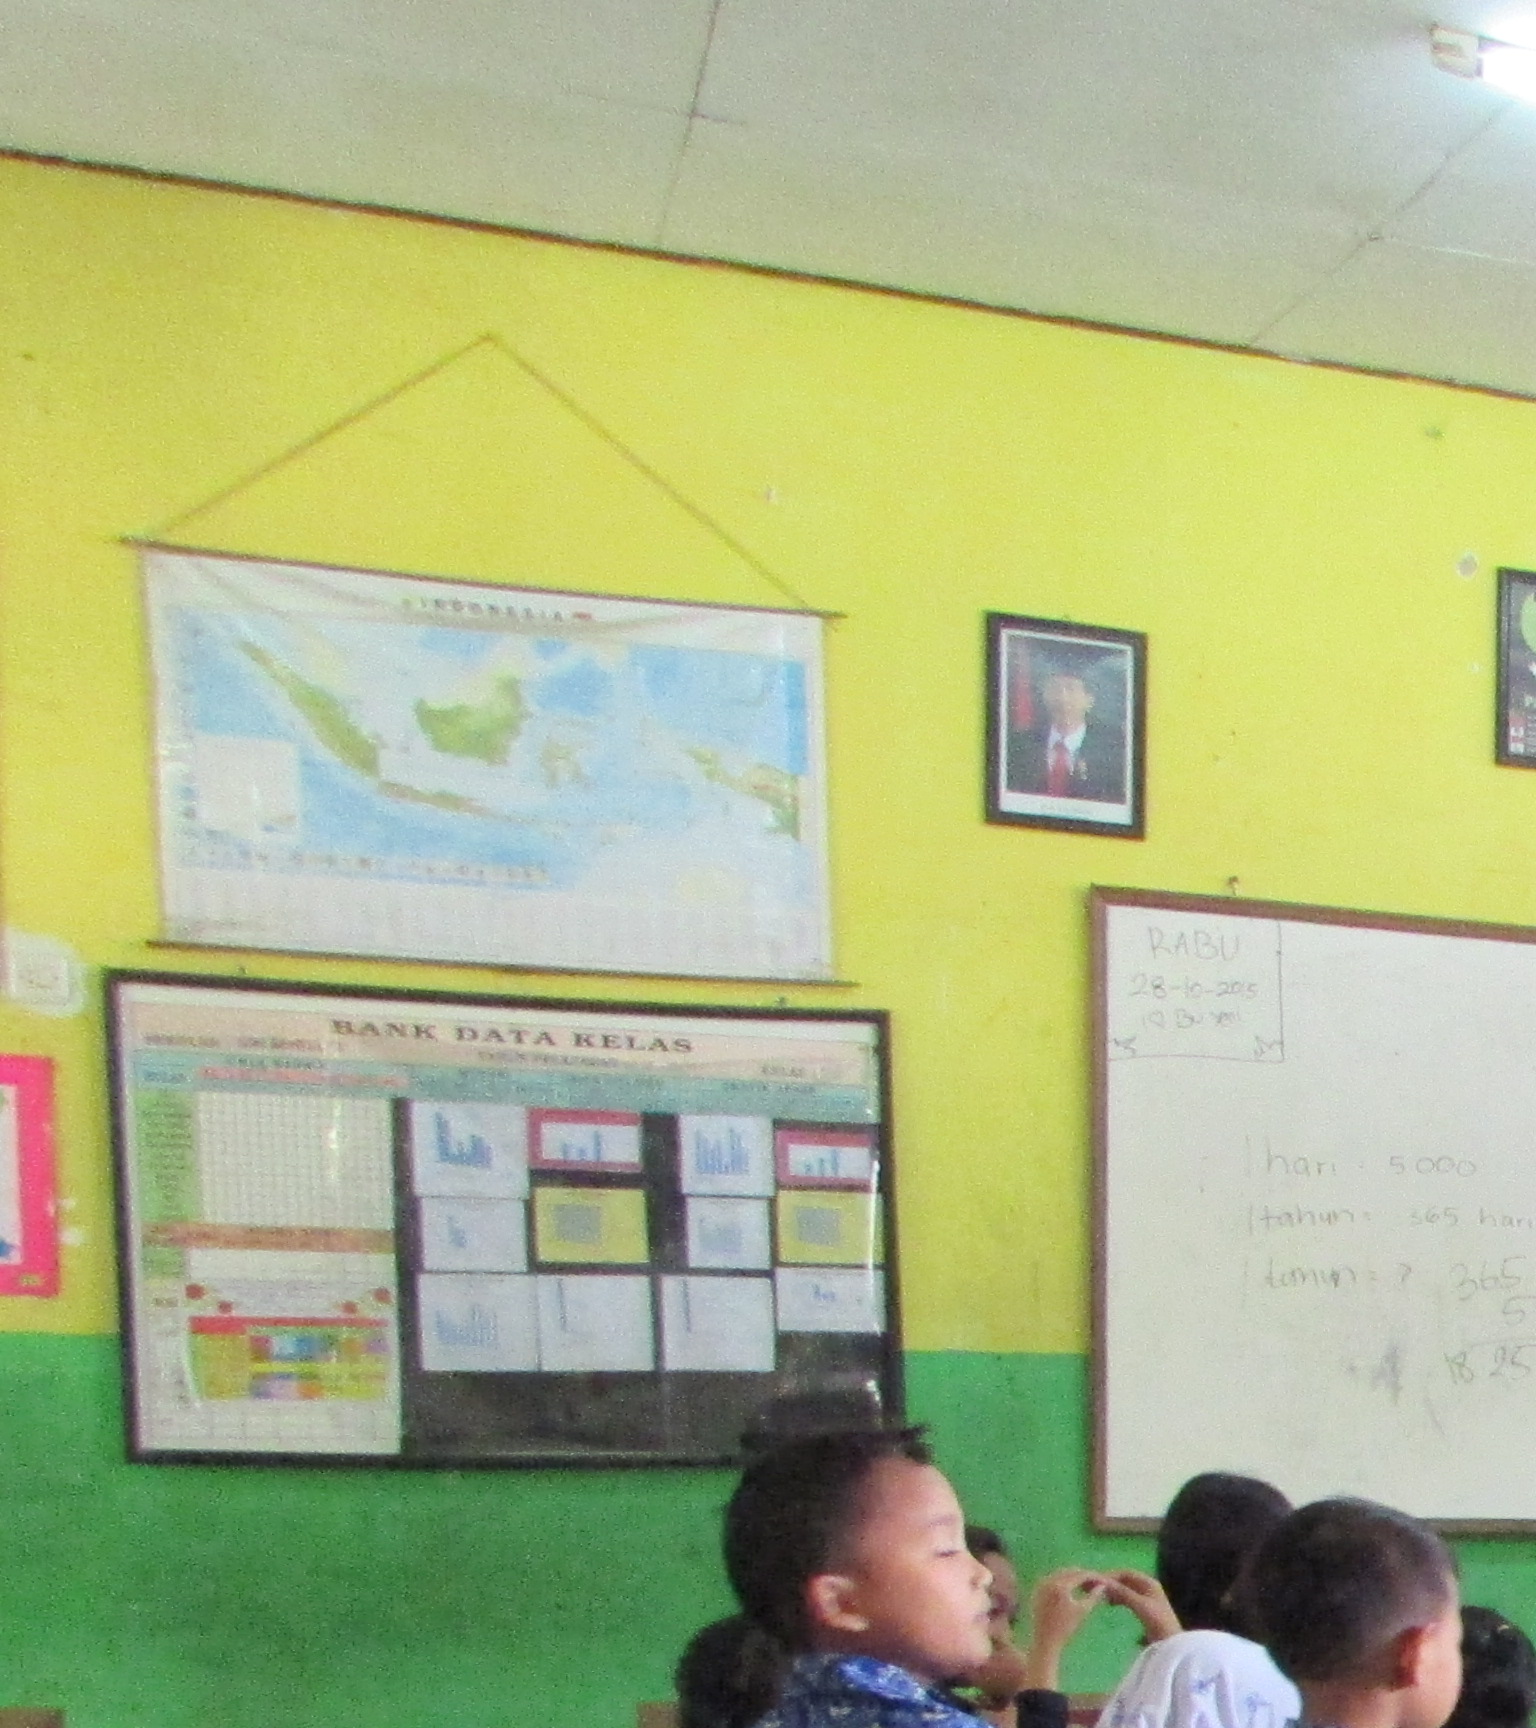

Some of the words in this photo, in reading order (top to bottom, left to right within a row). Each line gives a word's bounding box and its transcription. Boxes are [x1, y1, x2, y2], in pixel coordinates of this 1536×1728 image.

[1148, 926, 1240, 961] RABU
[333, 1020, 438, 1041] BANK
[455, 1026, 556, 1046] DATA
[573, 1032, 695, 1053] KELAS
